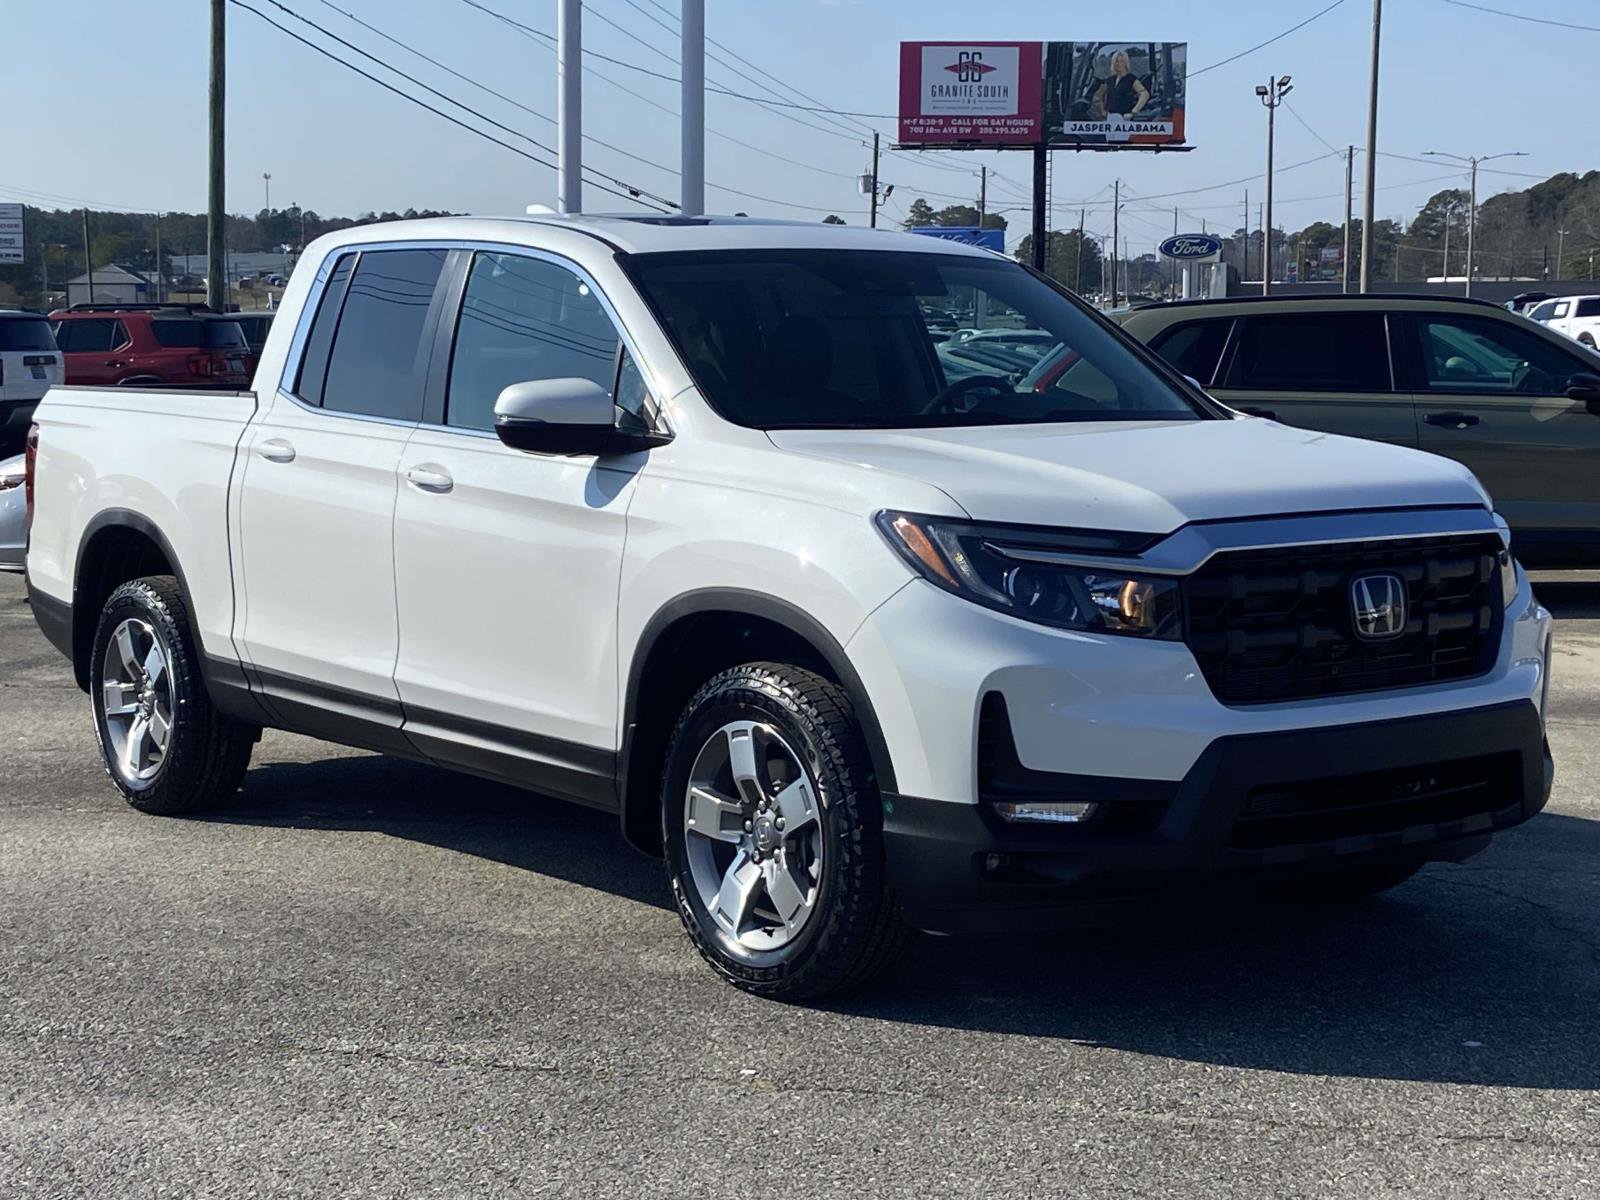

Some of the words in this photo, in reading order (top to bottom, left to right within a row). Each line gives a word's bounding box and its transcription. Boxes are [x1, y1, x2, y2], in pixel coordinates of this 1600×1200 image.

[931, 84, 974, 98] GRANITE
[977, 85, 1009, 98] SOUTH
[951, 118, 971, 126] CALL
[973, 118, 989, 126] FOR
[1006, 119, 1035, 127] HOURS
[1070, 123, 1112, 133] JASPER
[1115, 123, 1166, 133] ALABAMA
[1172, 238, 1210, 255] Ford
